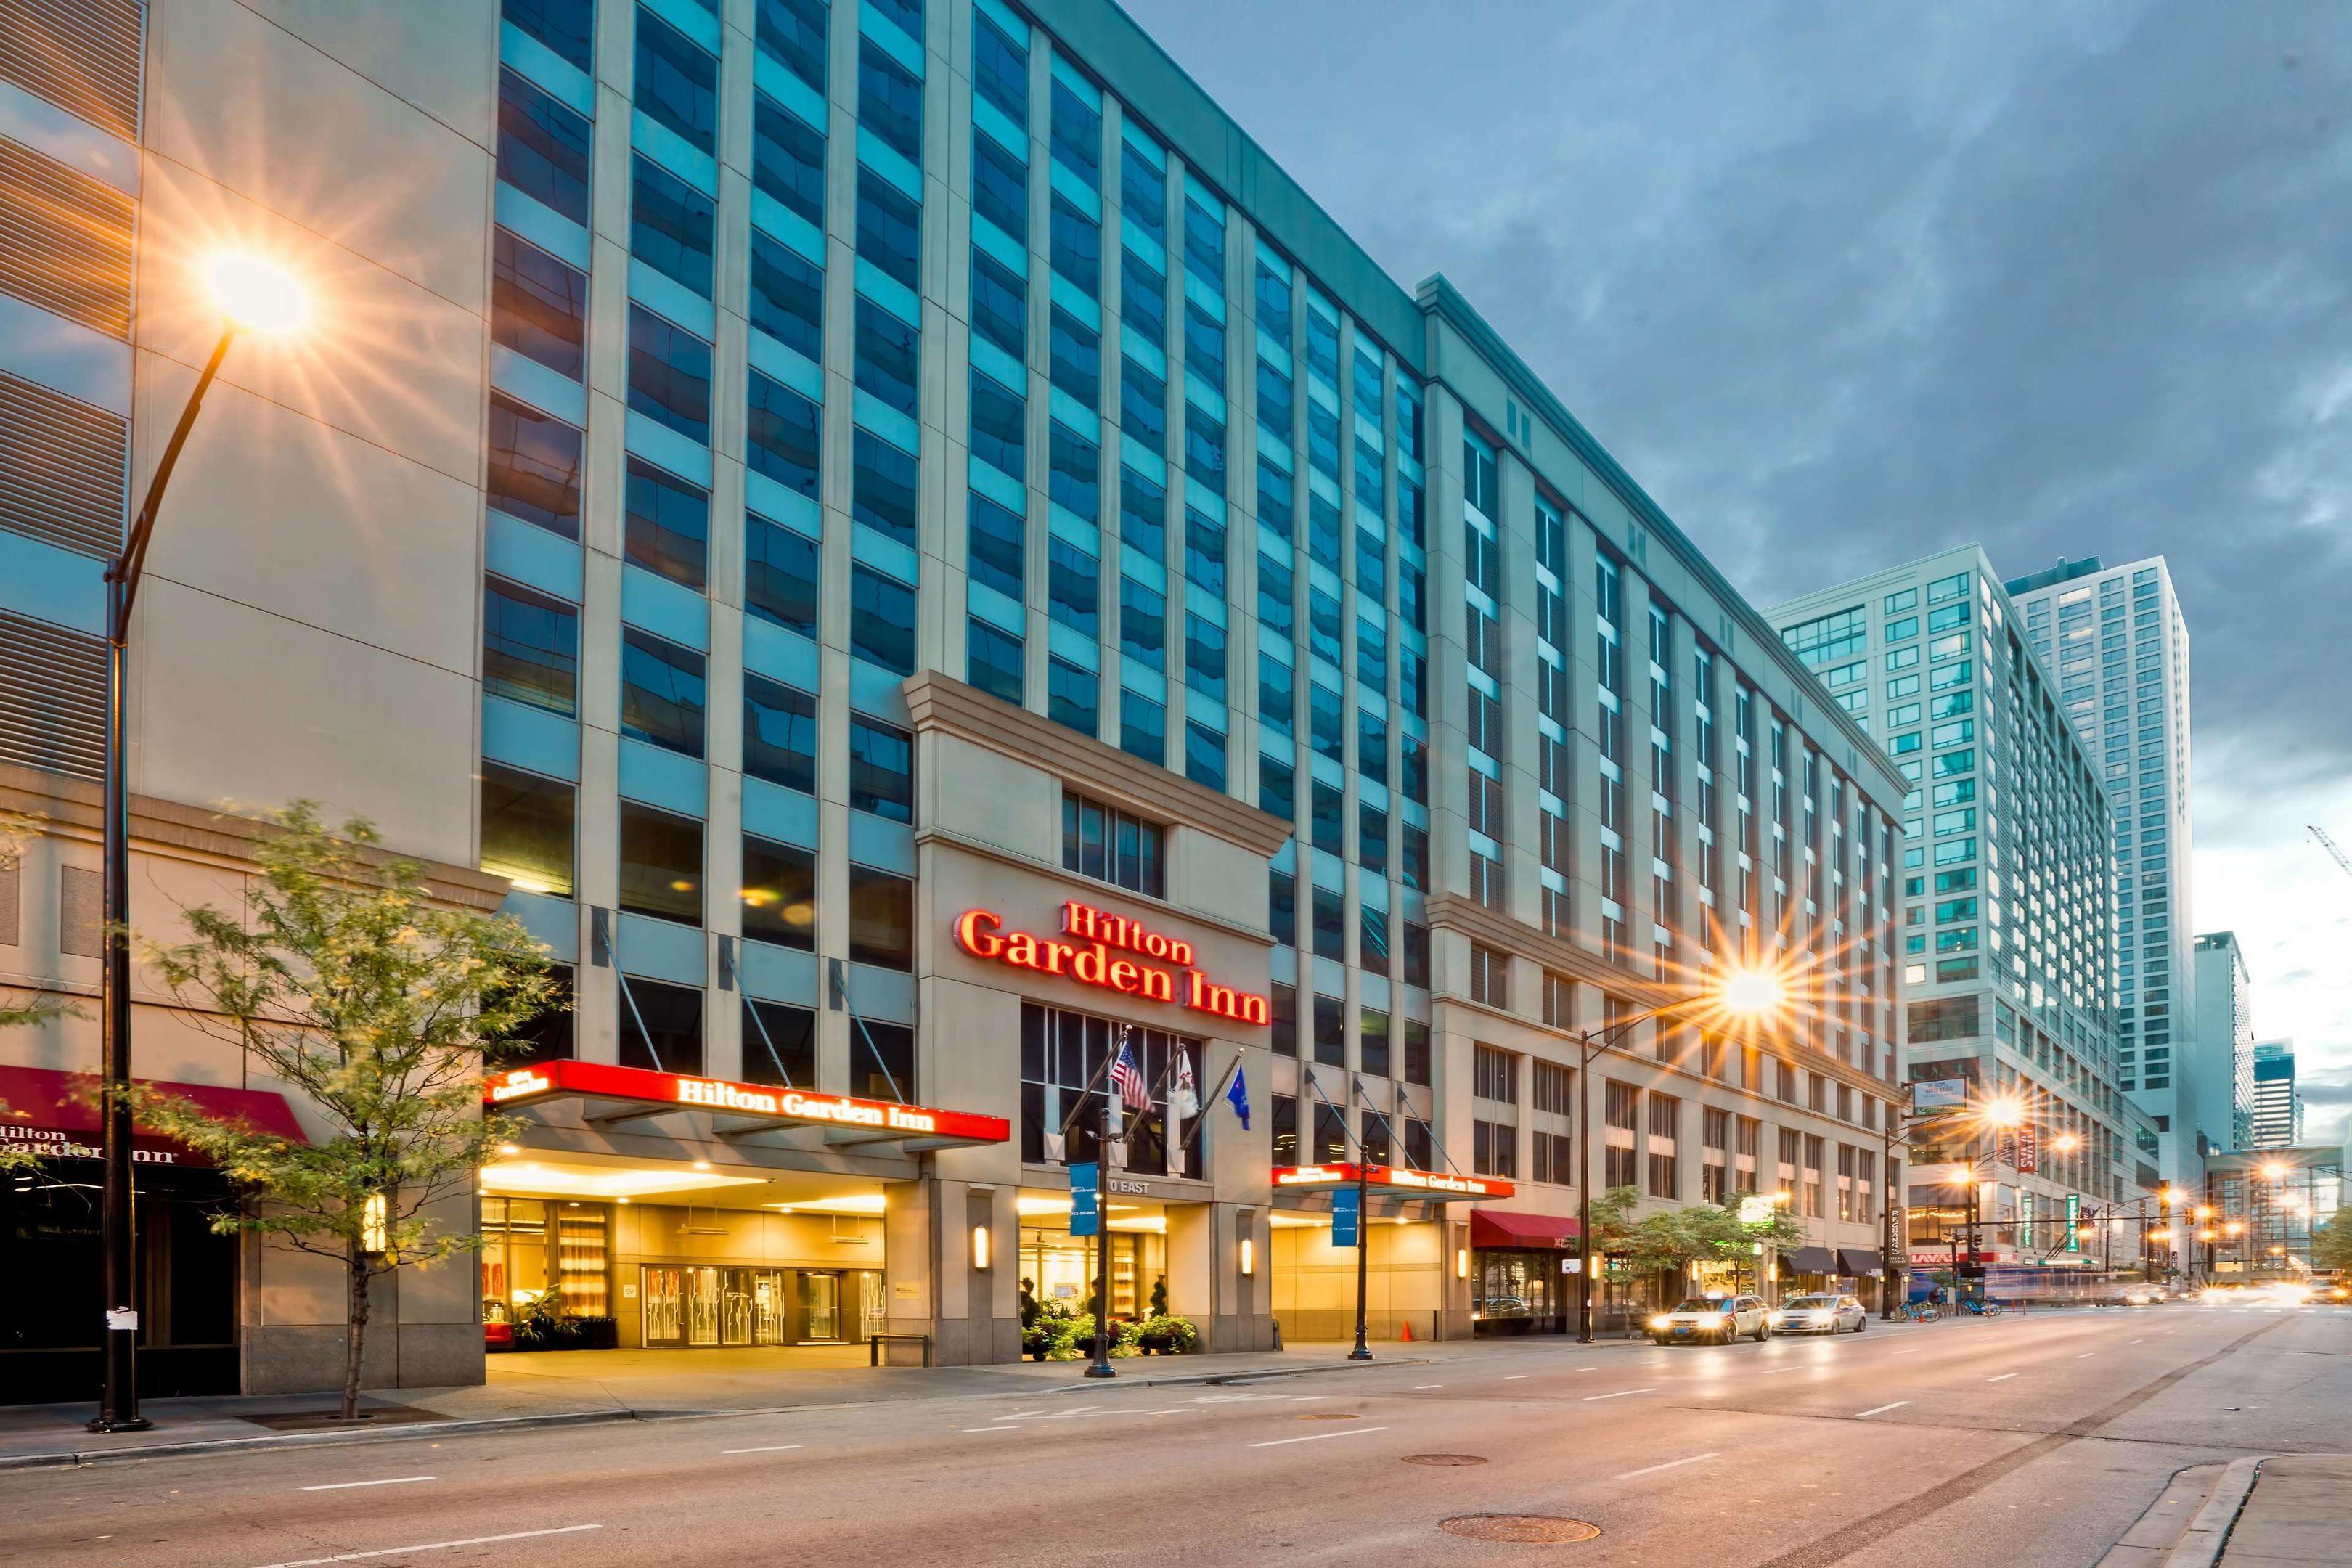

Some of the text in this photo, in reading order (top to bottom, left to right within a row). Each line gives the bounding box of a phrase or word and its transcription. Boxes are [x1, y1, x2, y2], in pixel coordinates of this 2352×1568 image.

[1063, 901, 1194, 966] Hilton
[954, 908, 1270, 1025] Garden Inn
[678, 1079, 935, 1132] Hilton Garden Inn
[133, 1150, 174, 1163] nn
[1120, 1180, 1149, 1194] EAST
[1428, 1175, 1466, 1191] Garden
[1467, 1180, 1485, 1193] Inn
